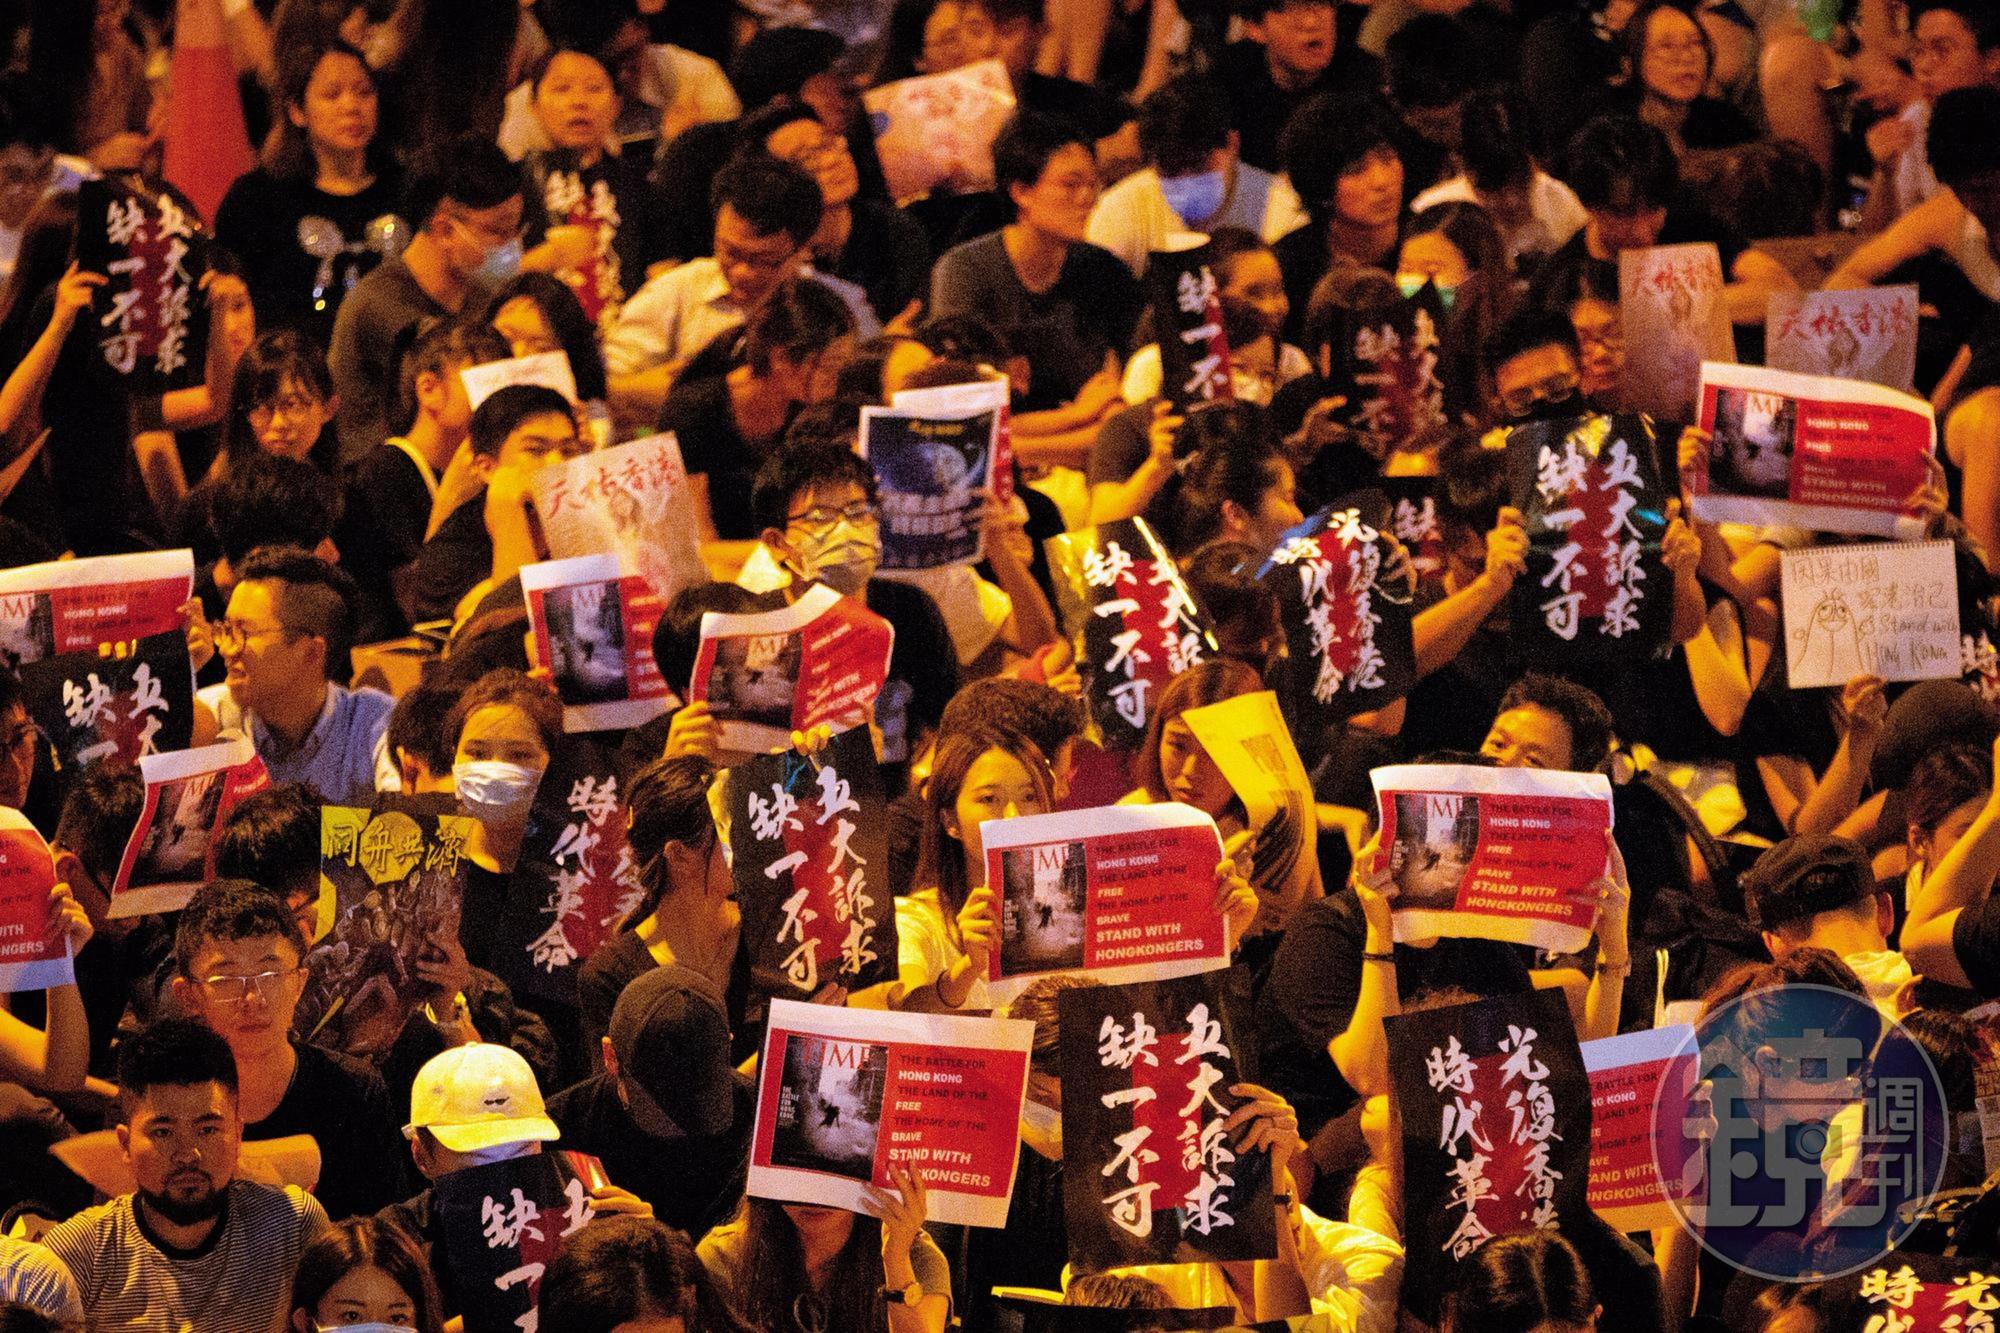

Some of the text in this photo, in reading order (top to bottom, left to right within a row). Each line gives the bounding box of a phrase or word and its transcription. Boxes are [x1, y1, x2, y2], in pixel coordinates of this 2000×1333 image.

[1536, 440, 1589, 641] 缺一不可
[1599, 438, 1648, 639] 五大訴求
[1084, 541, 1151, 728] 缺一不可
[1488, 817, 1551, 829] HONG KONG
[1486, 844, 1513, 855] FREE
[815, 765, 879, 976] 五大訴求
[1097, 854, 1159, 870] HONG KONG
[525, 775, 619, 975] 時代革命
[1476, 868, 1513, 880] BRAVE
[748, 782, 822, 993] 缺一不可
[1098, 886, 1124, 898] FREE
[1471, 880, 1557, 898] STAND WITH
[1466, 897, 1574, 917] HONGKONGERS
[1096, 913, 1131, 926] BRAVE
[1096, 922, 1182, 943] STAND WITH
[0, 940, 45, 956] NGERS
[1095, 938, 1205, 961] HONGKONGERS
[898, 1070, 963, 1084] HONG KONG
[895, 1101, 922, 1111] FREE
[1606, 1091, 1637, 1105] KONG
[1098, 1012, 1161, 1239] 缺一不可
[1174, 1003, 1236, 1236] 五大訴求
[890, 1131, 922, 1142] BRAVE
[888, 1147, 972, 1165] STAND WITH
[1425, 1035, 1500, 1263] 時代革命
[886, 1167, 991, 1188] KONGERS
[1624, 1162, 1657, 1180] WITH
